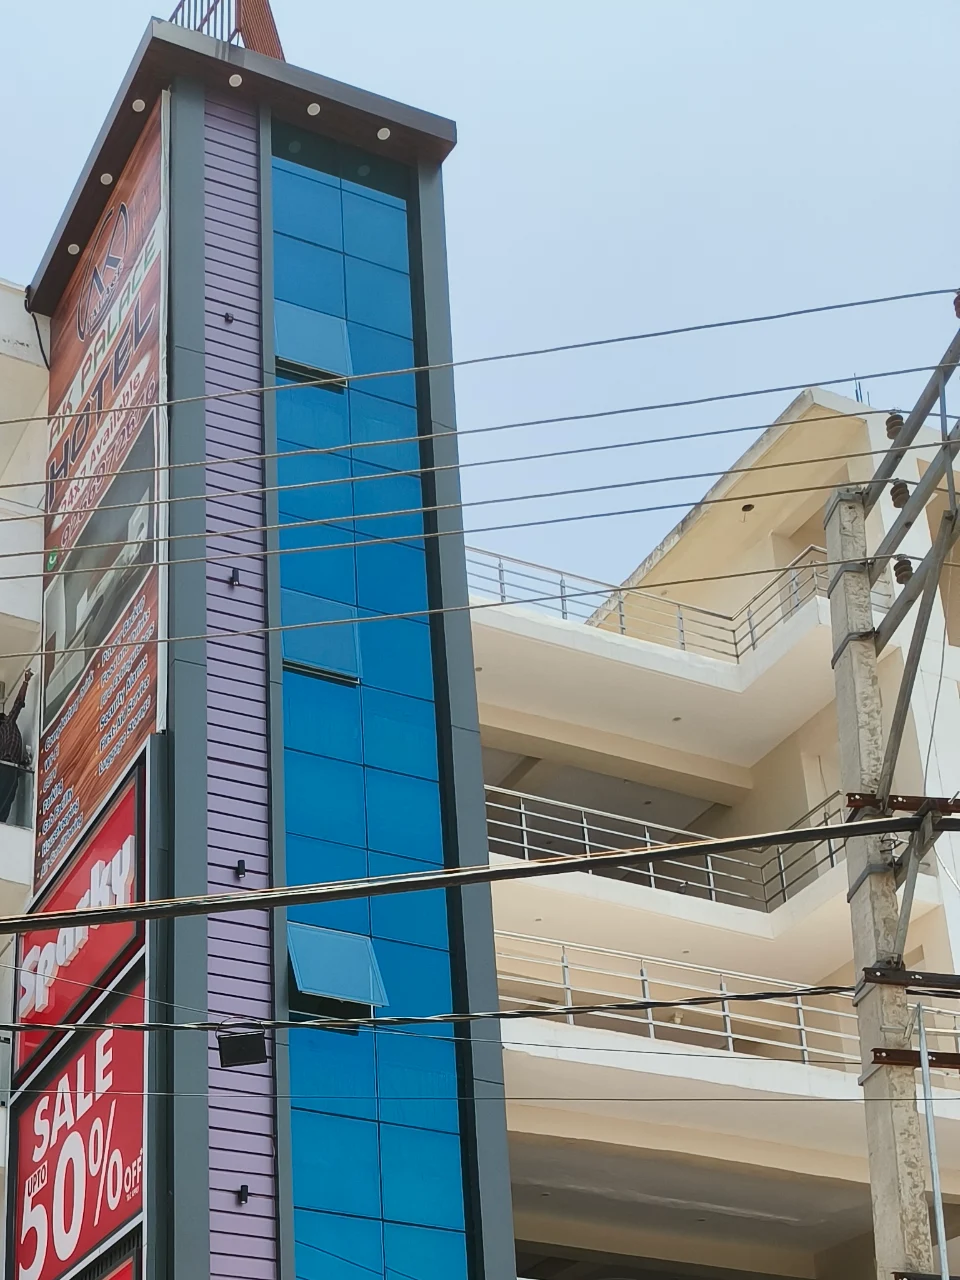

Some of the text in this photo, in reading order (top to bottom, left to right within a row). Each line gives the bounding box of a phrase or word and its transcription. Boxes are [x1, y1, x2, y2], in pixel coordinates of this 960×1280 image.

[81, 228, 156, 395] PALACE
[48, 293, 155, 514] HOTEL
[90, 370, 140, 468] Available
[99, 690, 125, 730] Security
[20, 835, 135, 1018] Sparky
[32, 1024, 114, 1163] SALE
[27, 1161, 48, 1196] UPTO
